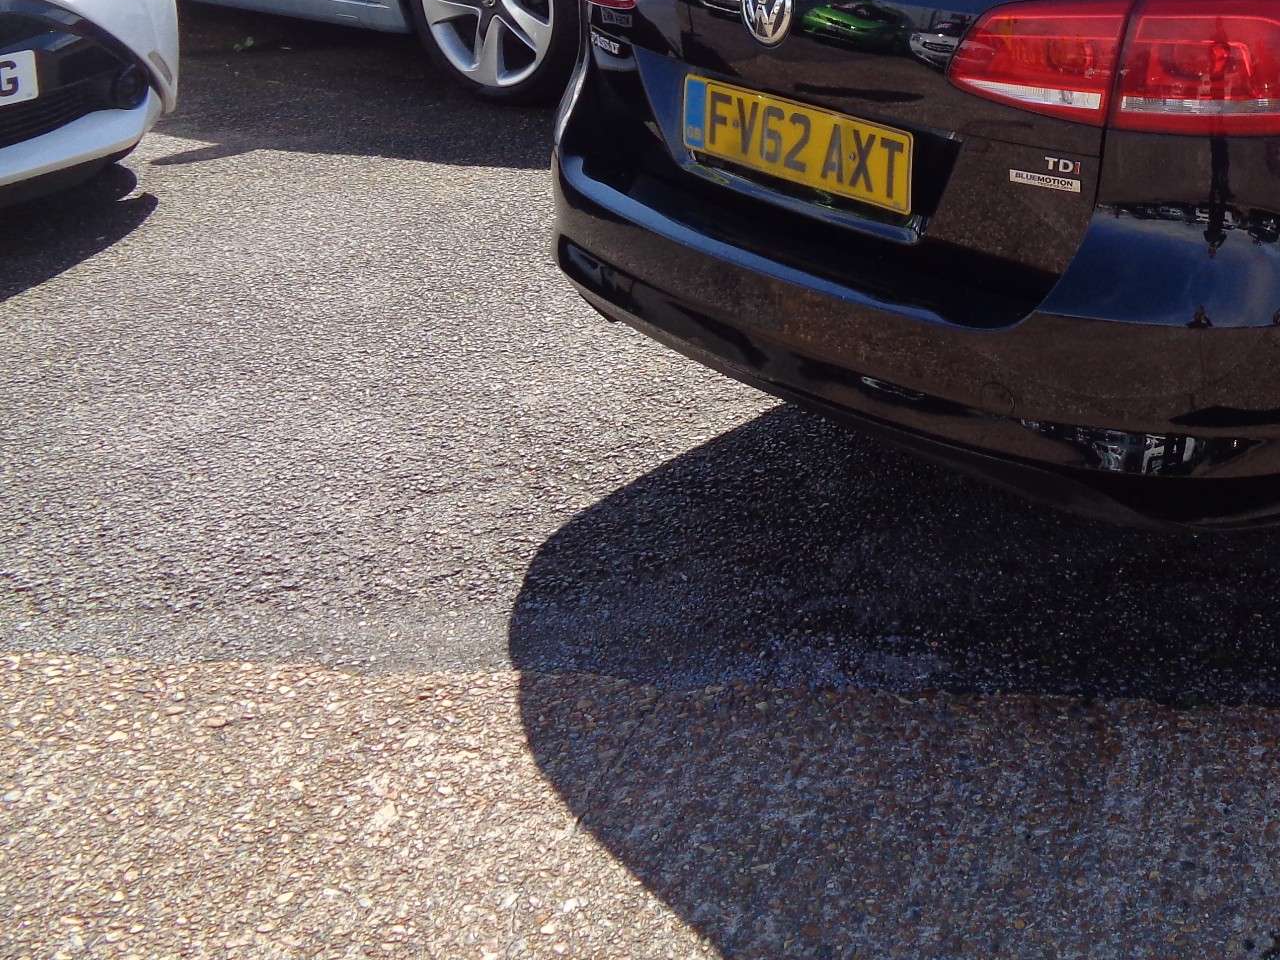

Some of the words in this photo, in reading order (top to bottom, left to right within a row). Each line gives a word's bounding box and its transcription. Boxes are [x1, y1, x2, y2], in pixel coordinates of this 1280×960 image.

[709, 91, 812, 173] FV62
[821, 123, 904, 199] AXT
[1015, 172, 1073, 188] BLUEMOTION
